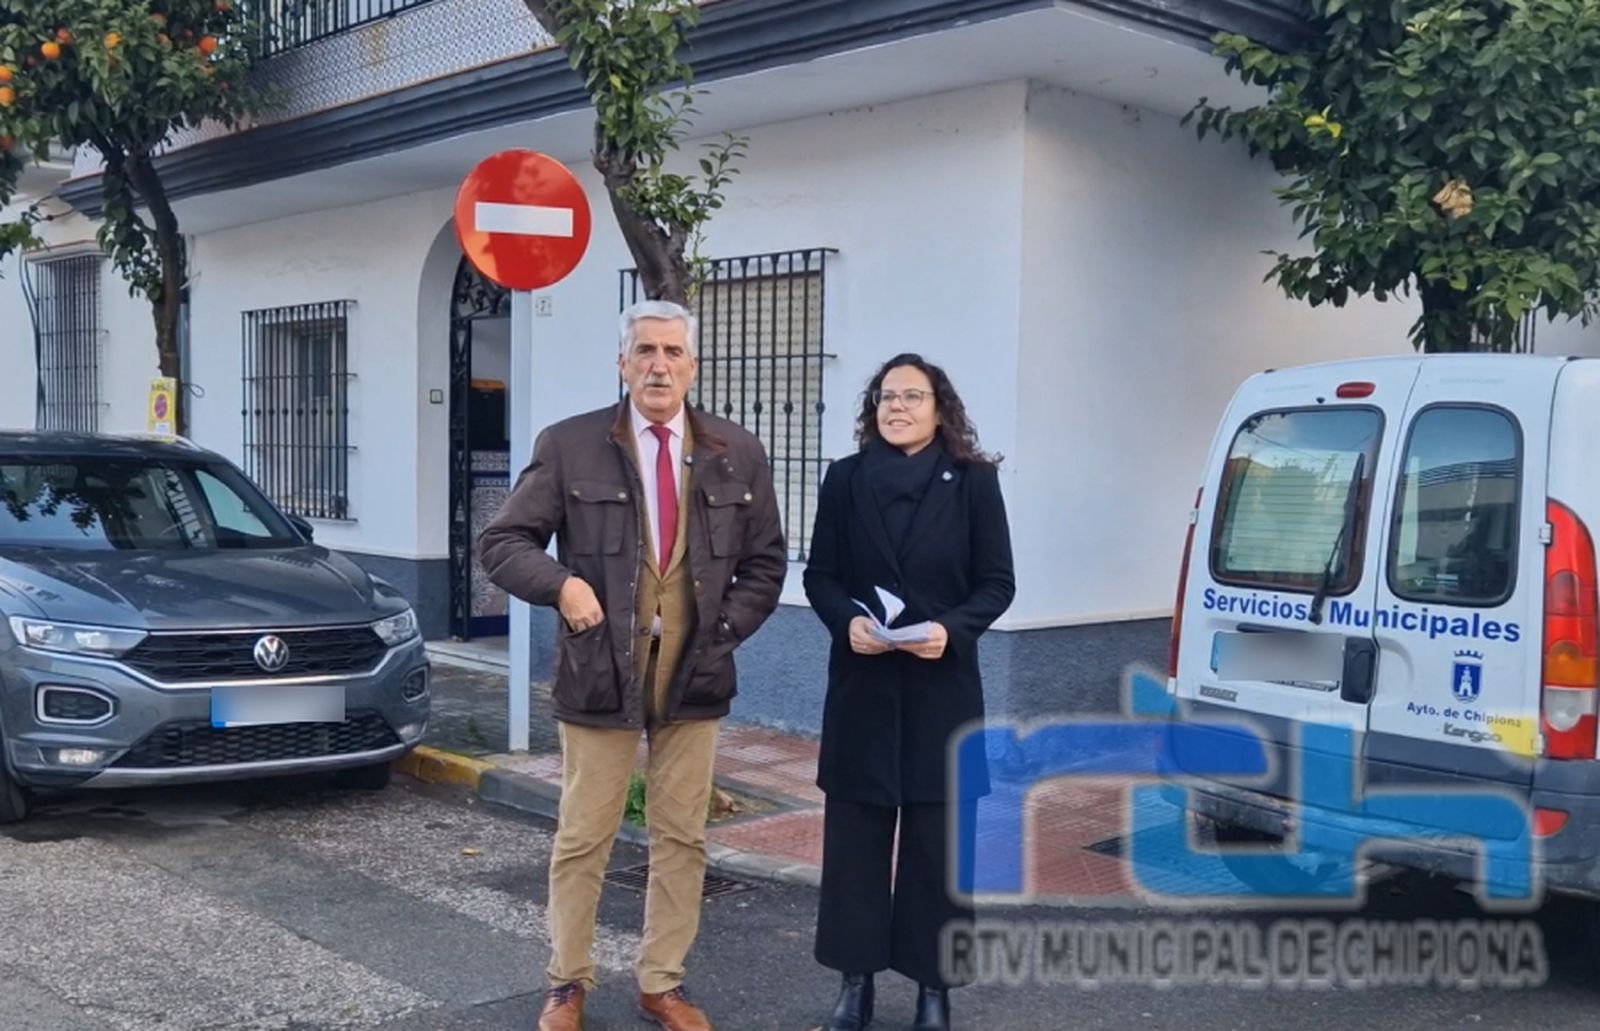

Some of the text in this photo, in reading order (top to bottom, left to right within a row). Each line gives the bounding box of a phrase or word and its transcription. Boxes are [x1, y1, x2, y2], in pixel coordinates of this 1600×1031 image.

[1203, 588, 1521, 642] Servicios Municipales
[1407, 702, 1522, 728] Ayto. de Chipiona
